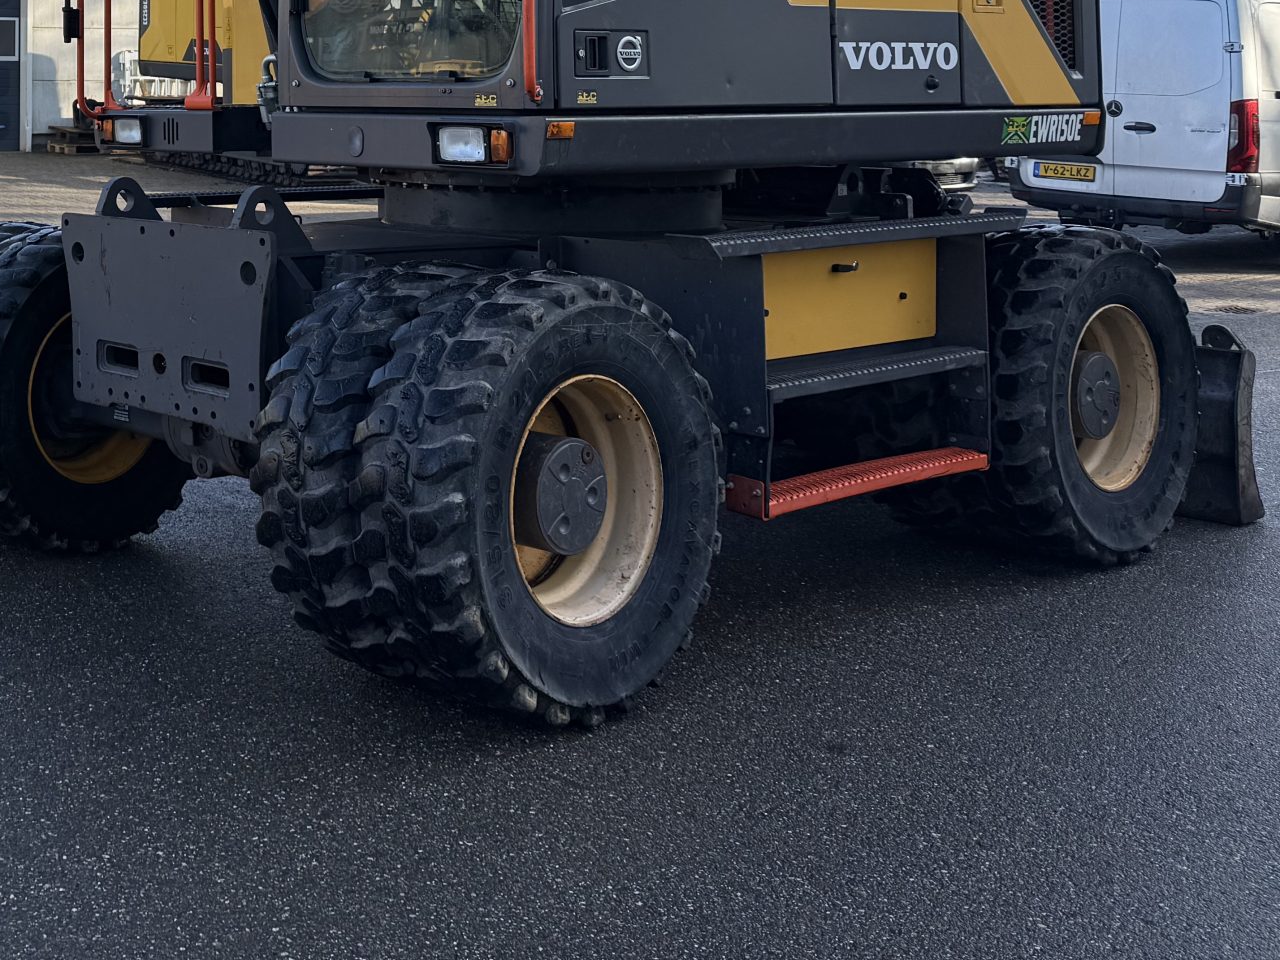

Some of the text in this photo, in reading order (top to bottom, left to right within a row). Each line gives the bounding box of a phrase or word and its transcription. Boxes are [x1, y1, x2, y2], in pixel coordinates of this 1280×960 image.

[839, 41, 958, 71] VOLVO
[1029, 114, 1083, 143] EWR150E
[1043, 165, 1090, 178] V-62-LKZ
